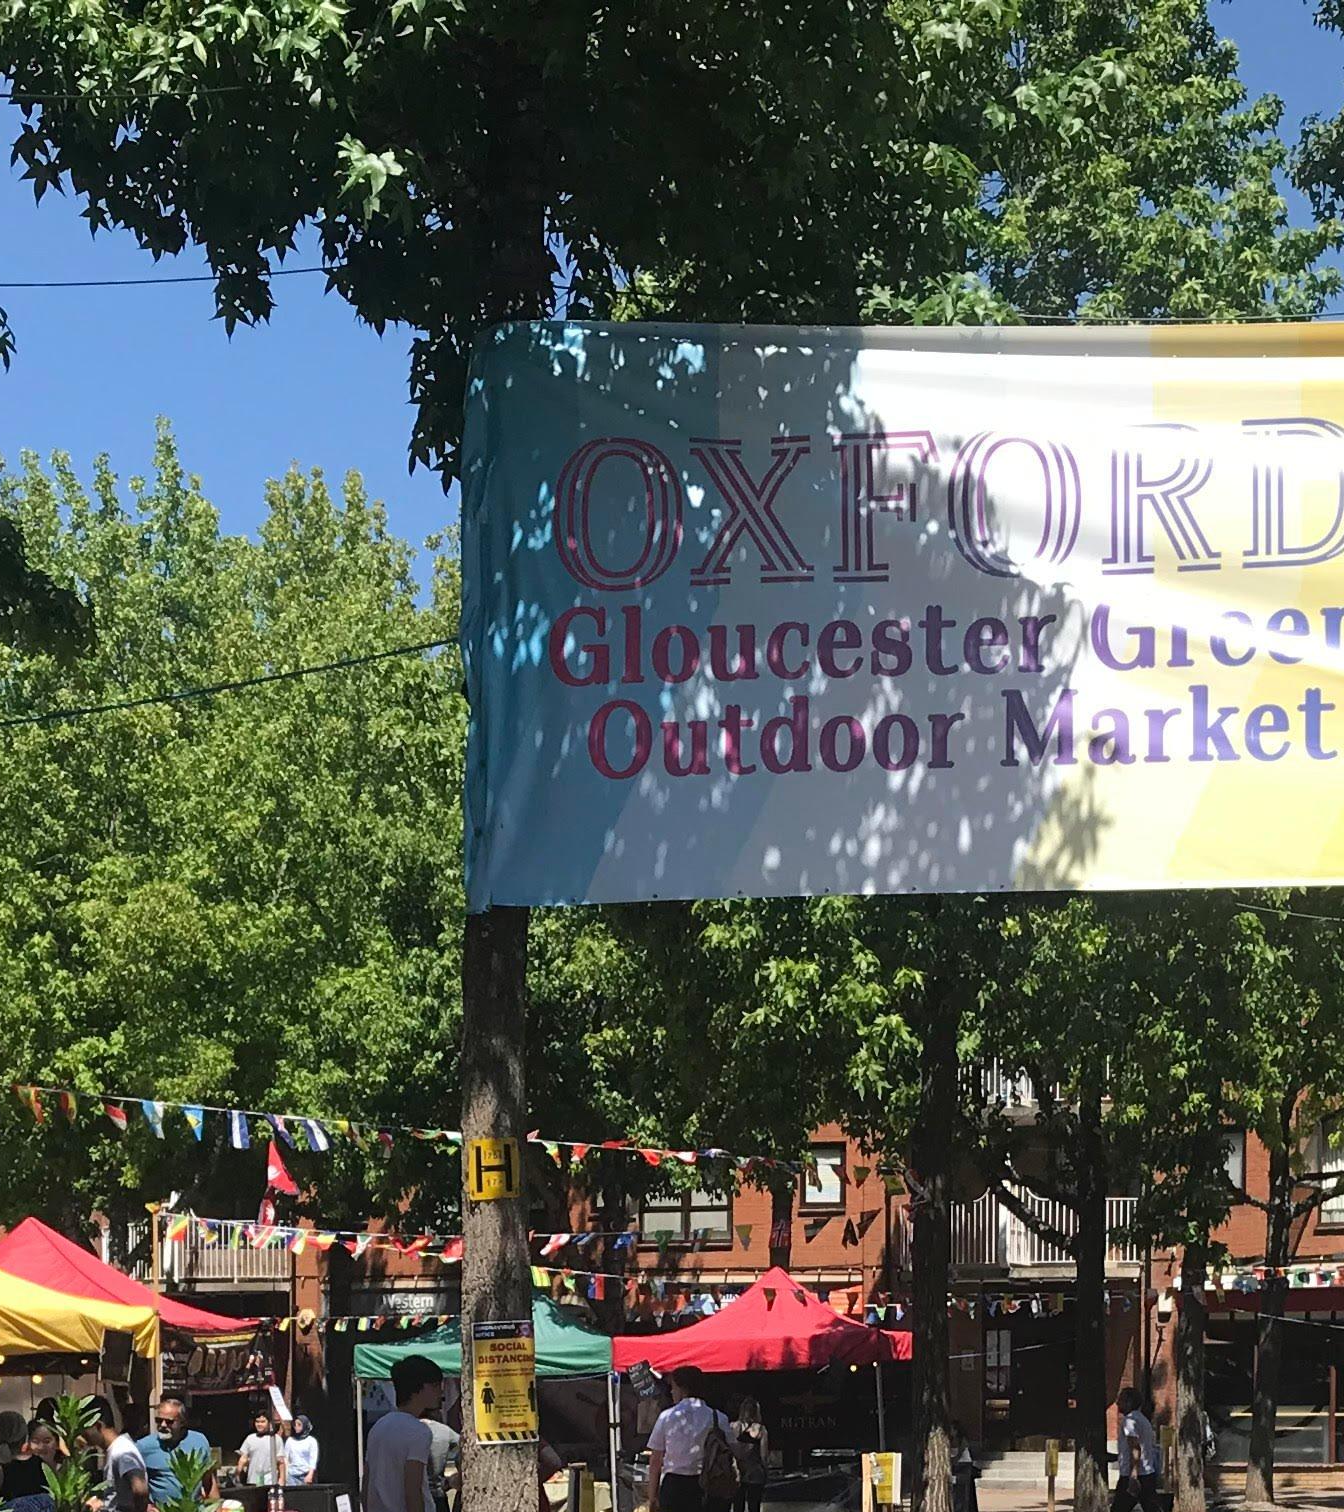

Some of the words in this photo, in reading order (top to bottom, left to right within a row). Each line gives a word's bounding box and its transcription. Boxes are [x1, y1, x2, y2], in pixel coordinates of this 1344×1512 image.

[548, 604, 1056, 688] Gloucester
[587, 690, 965, 780] Outdoor
[1000, 684, 1338, 767] Market
[476, 1144, 513, 1193] H
[383, 1294, 435, 1309] Western
[490, 1342, 528, 1352] SOCIAL
